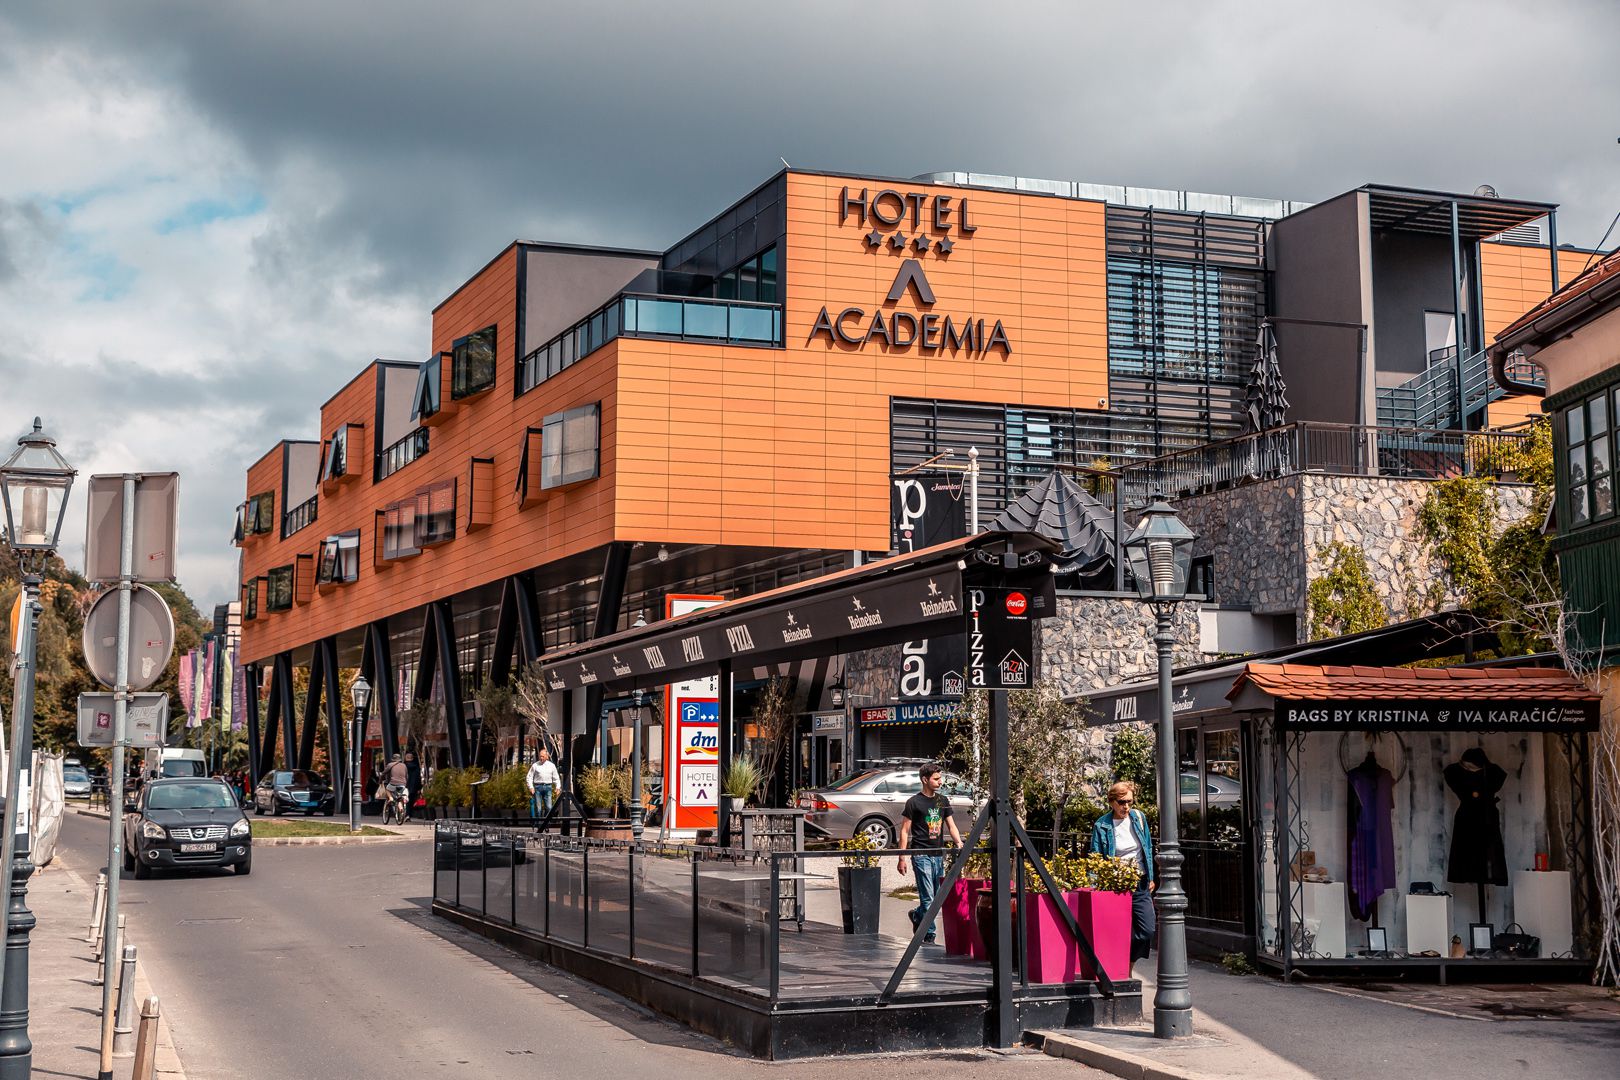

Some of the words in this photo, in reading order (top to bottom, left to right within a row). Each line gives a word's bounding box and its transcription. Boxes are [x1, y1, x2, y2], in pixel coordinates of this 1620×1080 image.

[841, 186, 977, 231] HOTEL
[808, 306, 1012, 353] ACADEMIA
[920, 595, 957, 617] Heineken
[848, 610, 883, 630] Heineken
[726, 624, 755, 653] PIZZA
[782, 624, 812, 643] Heineken
[969, 589, 986, 685] pizza
[643, 645, 666, 669] PIZZA
[681, 635, 704, 662] PIZZA
[1004, 660, 1023, 673] PIZZA
[1004, 672, 1023, 683] HOUSE
[687, 709, 696, 720] P
[866, 711, 888, 720] SPAR
[901, 704, 925, 719] ULAZ
[1114, 696, 1137, 720] PIZZA
[1288, 710, 1329, 722] BAGS
[1334, 710, 1353, 722] BY
[1357, 710, 1430, 722] KRISTINA
[1437, 710, 1450, 721] &
[1458, 711, 1483, 723] IVA
[691, 731, 717, 747] dm
[687, 773, 718, 781] HOTEL
